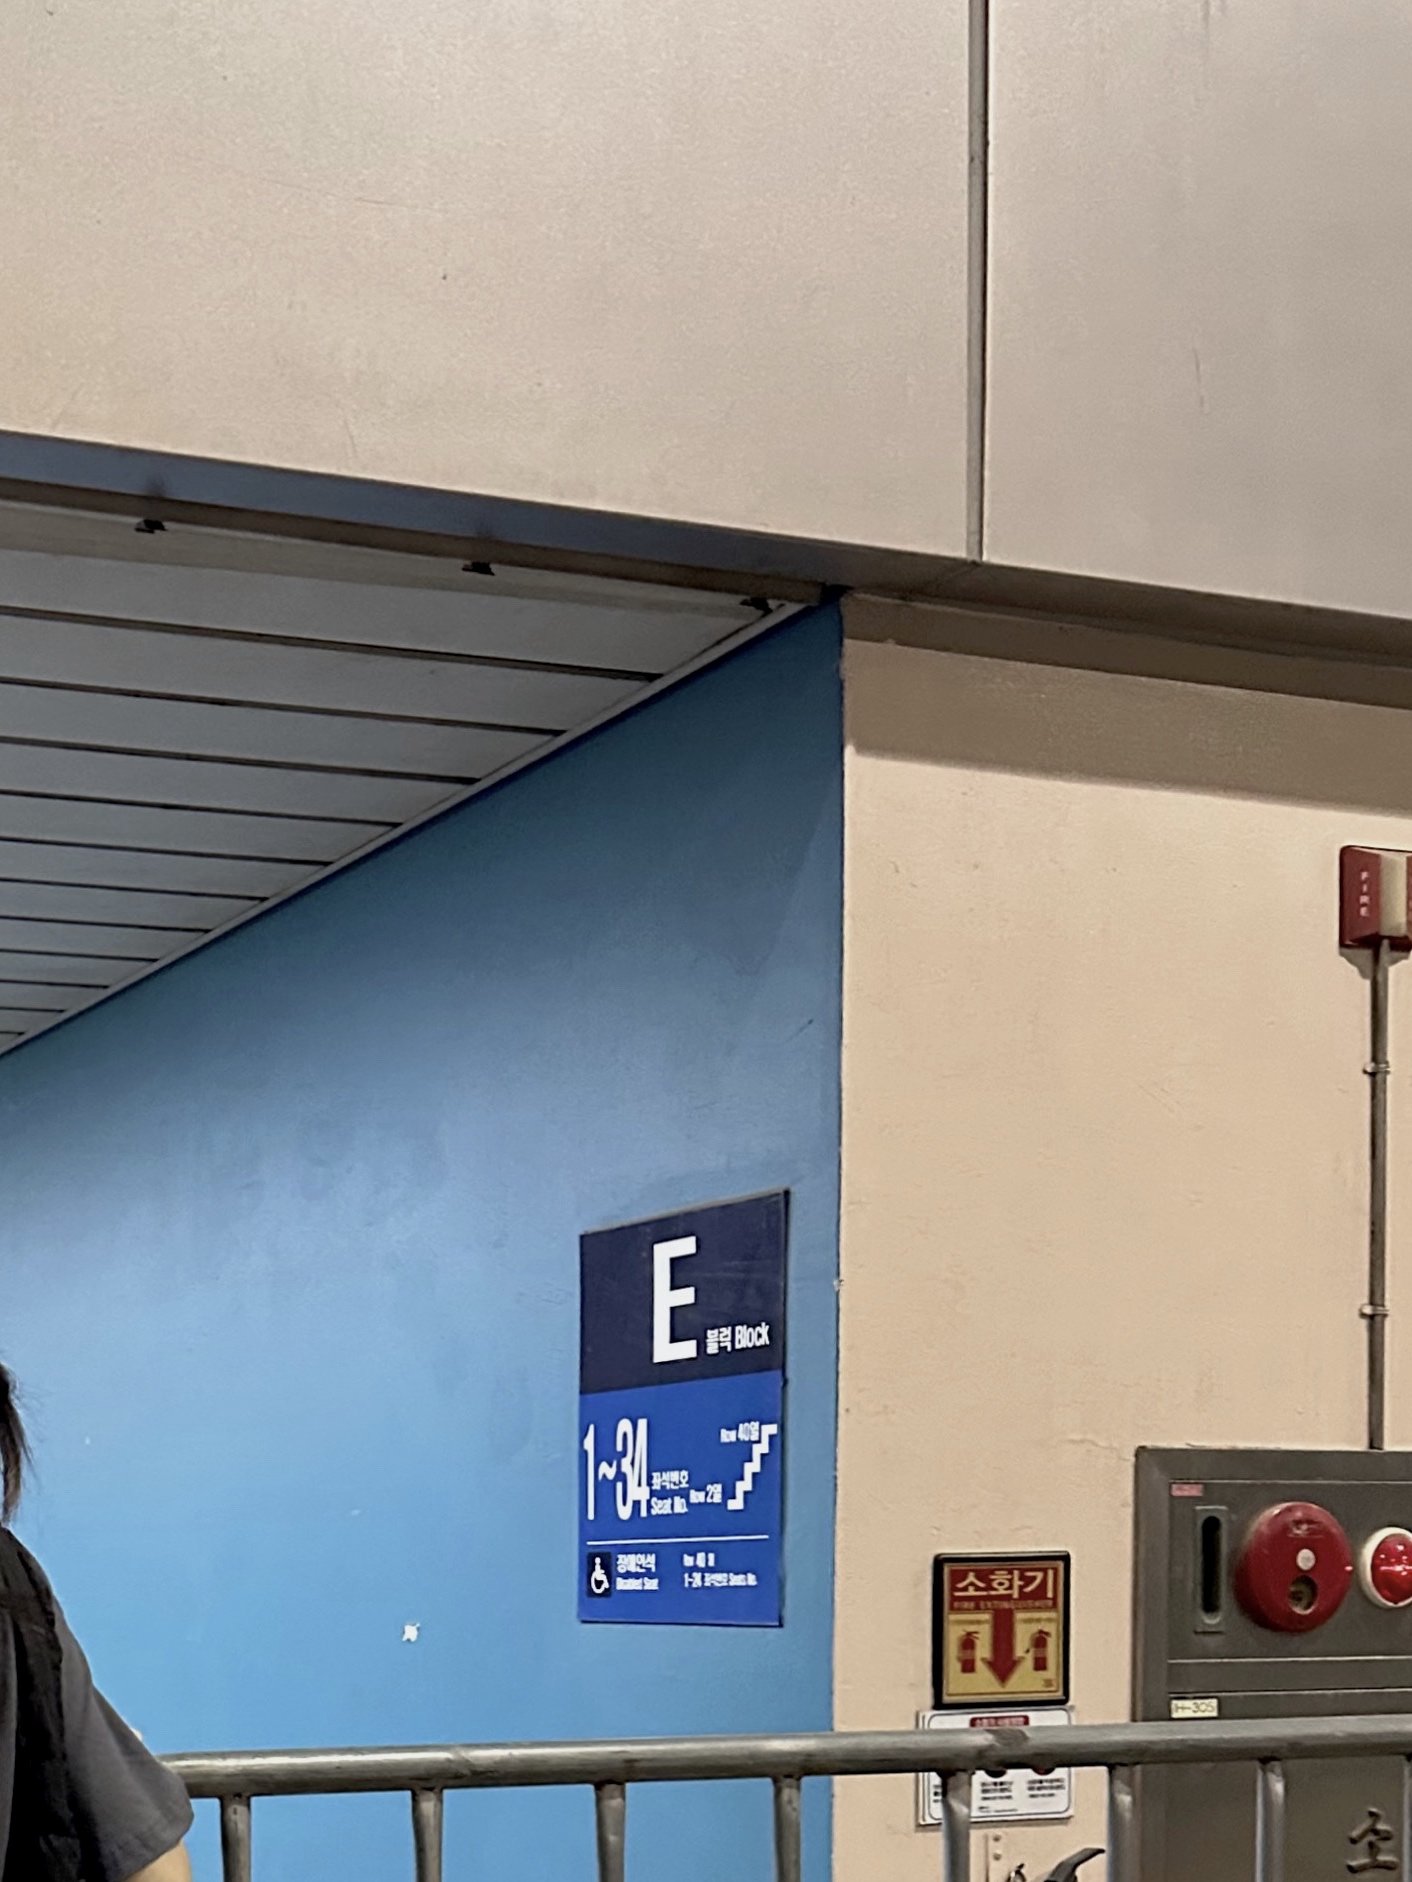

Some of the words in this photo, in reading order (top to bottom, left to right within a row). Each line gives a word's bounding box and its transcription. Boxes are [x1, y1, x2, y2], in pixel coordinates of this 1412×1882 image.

[653, 1235, 697, 1363] E
[706, 1326, 732, 1355] 블럭
[735, 1322, 770, 1349] Block
[651, 1470, 689, 1490] 좌석번호
[651, 1497, 672, 1515] Seat
[953, 1569, 1054, 1598] 소화기
